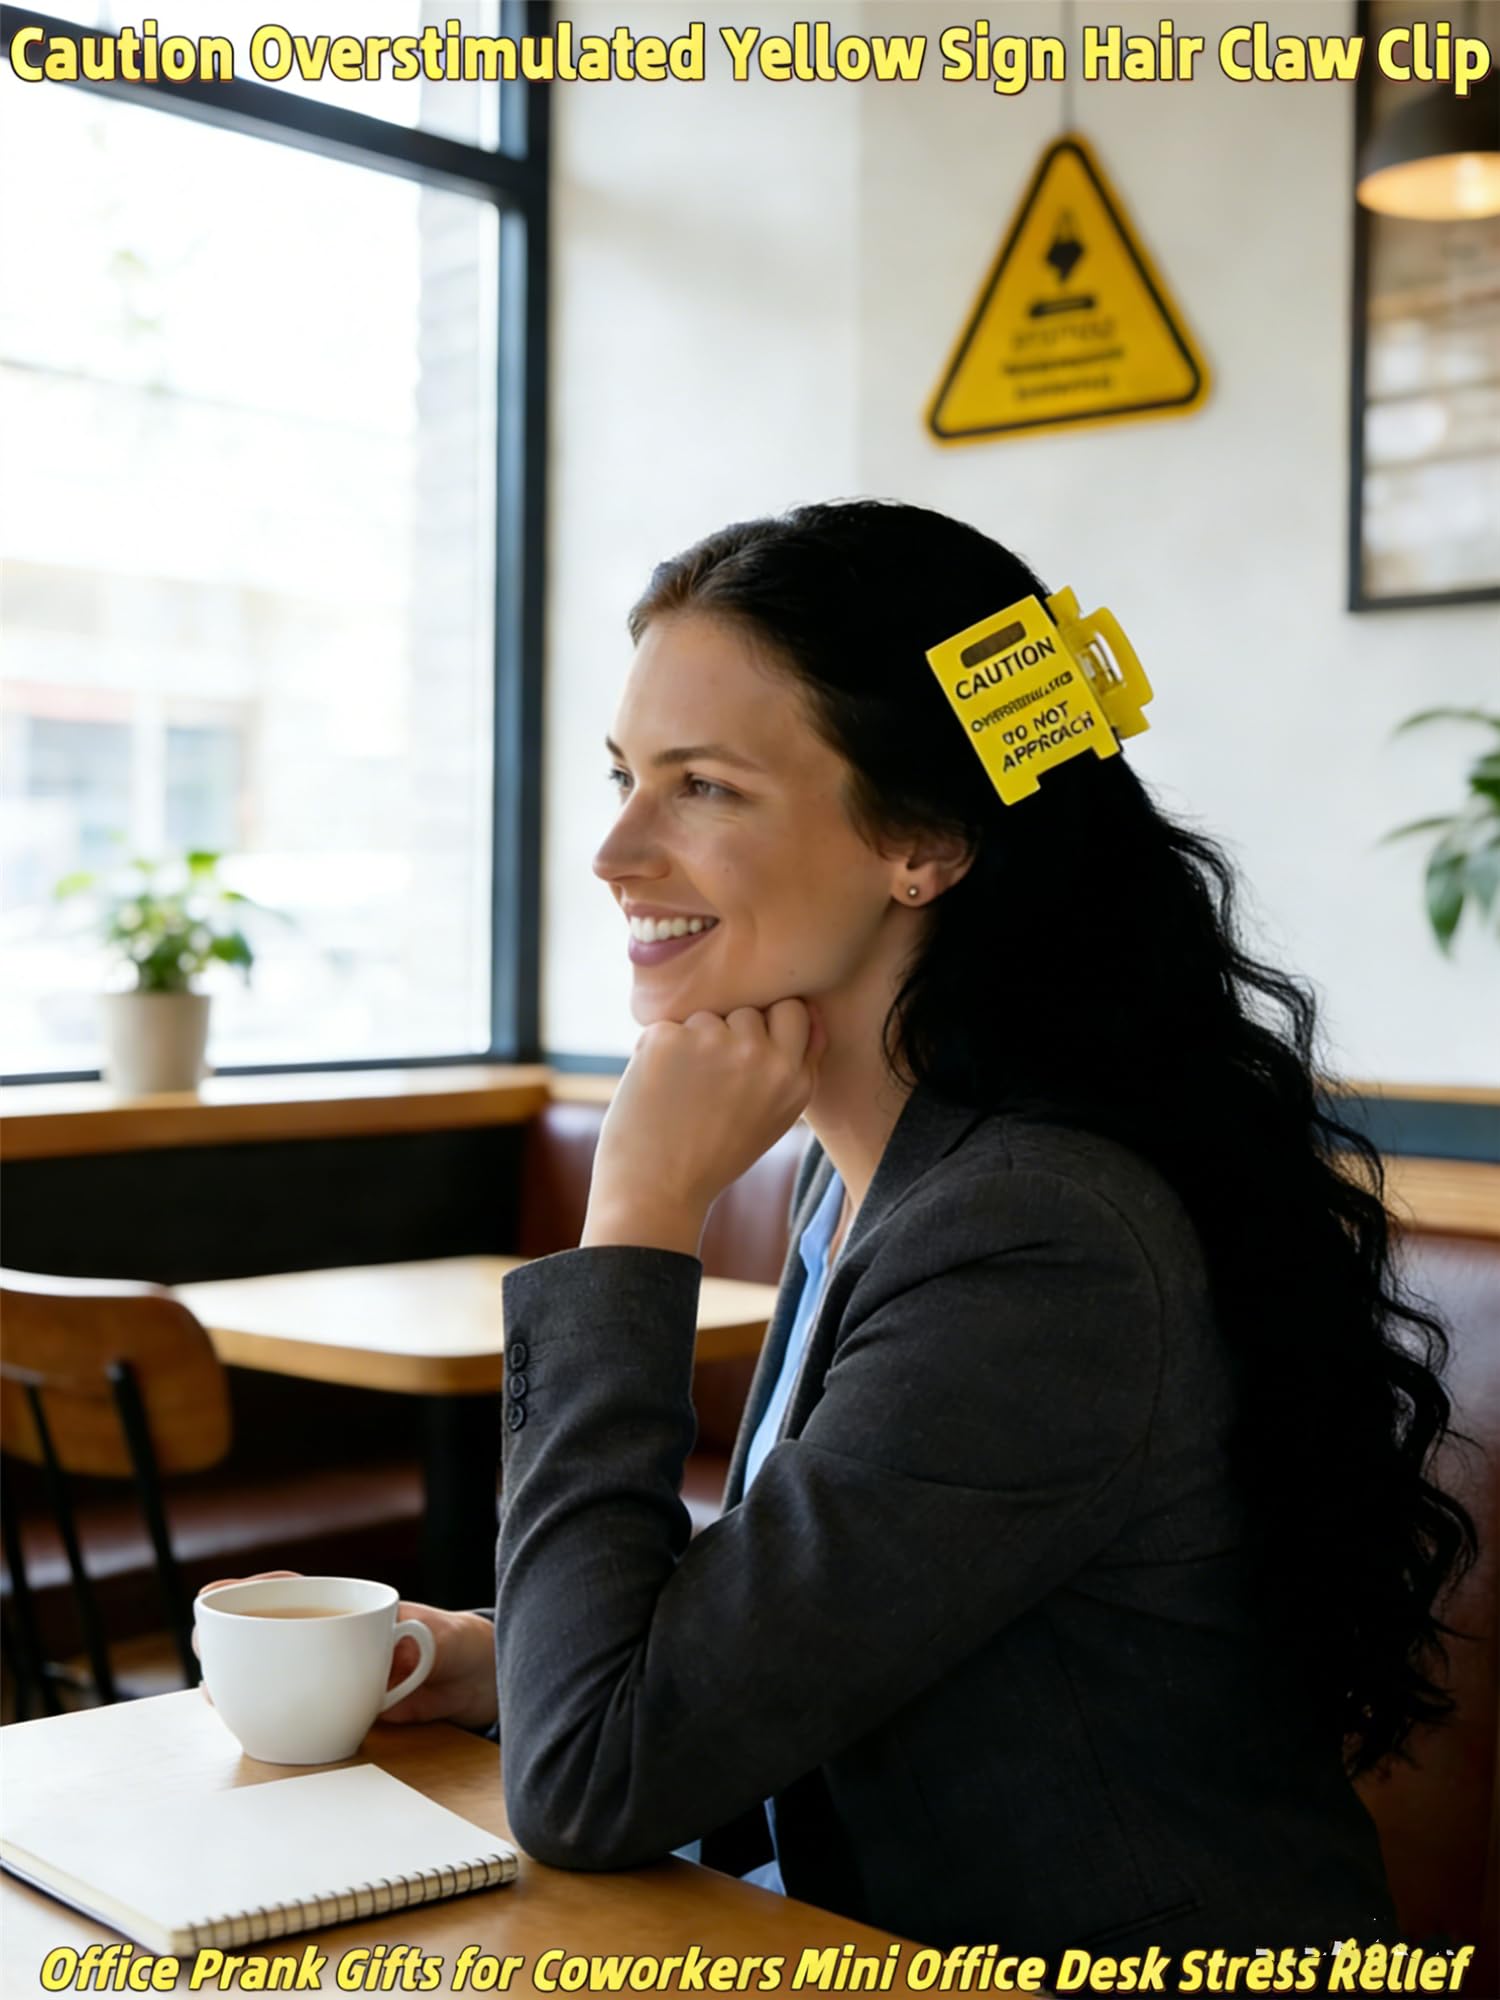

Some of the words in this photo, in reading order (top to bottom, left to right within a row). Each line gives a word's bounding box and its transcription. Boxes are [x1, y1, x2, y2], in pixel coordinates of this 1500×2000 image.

[956, 636, 1056, 700] CAUTION
[1002, 725, 1027, 746] DO
[1033, 700, 1070, 732] NOT
[1002, 711, 1095, 773] APPROACH
